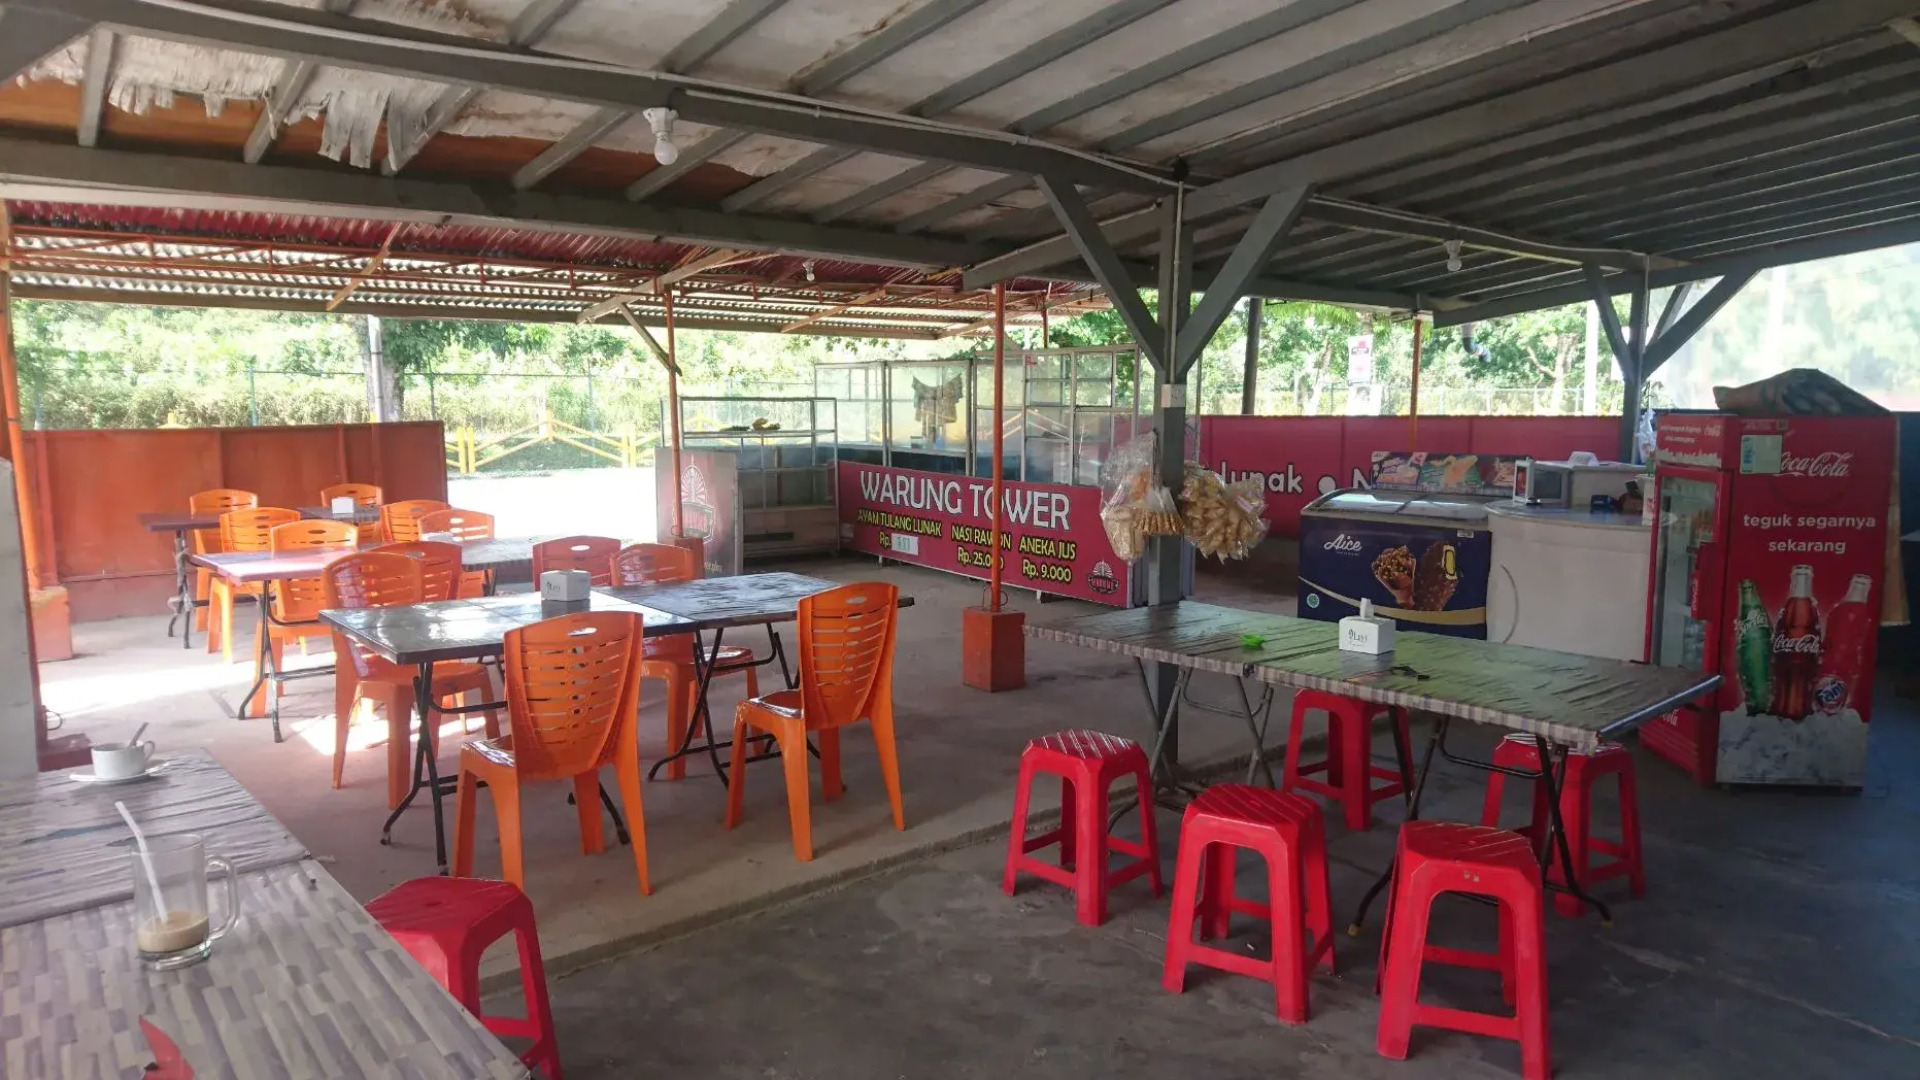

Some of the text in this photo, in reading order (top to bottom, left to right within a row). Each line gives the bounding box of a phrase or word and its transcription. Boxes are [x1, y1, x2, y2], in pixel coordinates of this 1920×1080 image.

[859, 470, 1070, 531] WARUNG TOWER
[857, 509, 942, 537] AYAM TULANG LUNAK
[1743, 514, 1876, 529] teguk segarnya
[879, 531, 892, 548] Rp.
[951, 525, 1011, 549] NASI RAWN
[1019, 536, 1076, 560] ANEKA JUS
[1323, 533, 1363, 551] Aice
[1768, 539, 1846, 554] sekarang
[957, 546, 1004, 570] Rp. 25.0
[1022, 559, 1072, 582] Rp. 9.000
